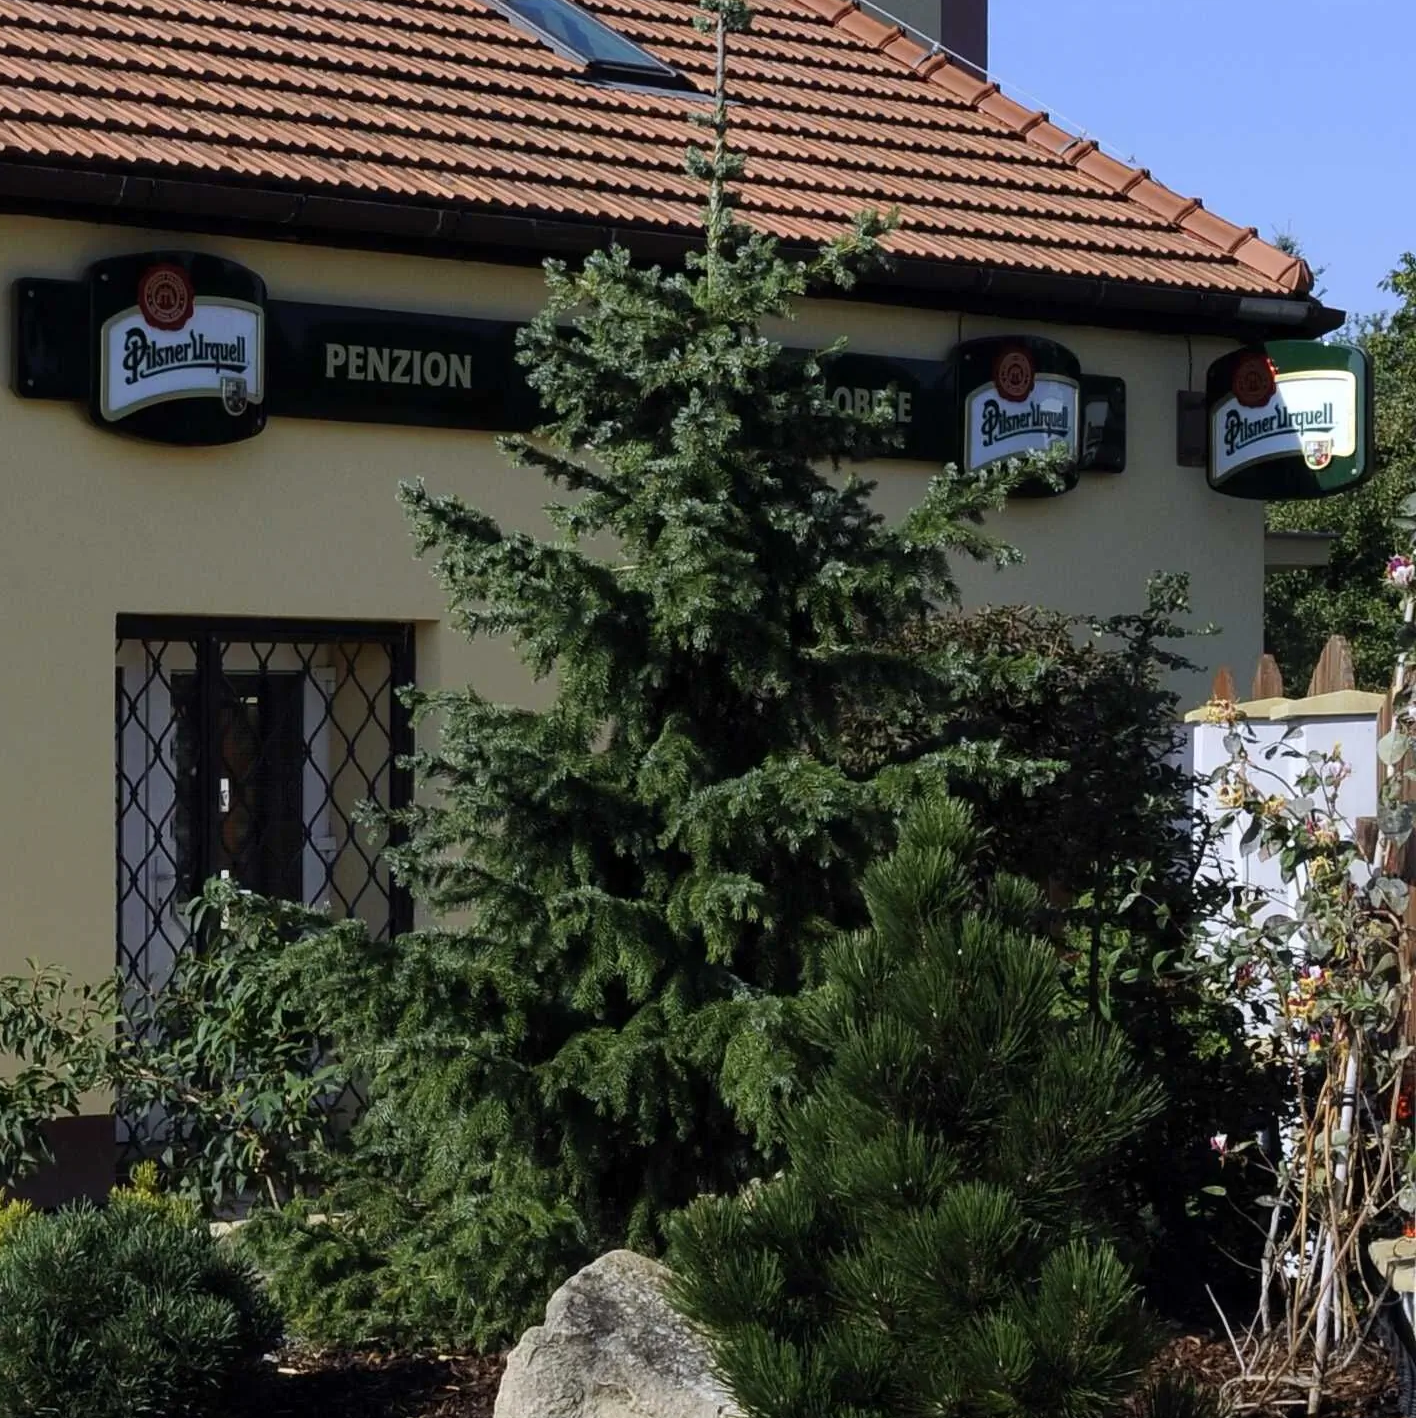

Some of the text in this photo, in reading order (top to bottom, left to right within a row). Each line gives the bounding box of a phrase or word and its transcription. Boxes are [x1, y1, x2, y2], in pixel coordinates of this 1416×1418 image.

[122, 326, 246, 385] Pilsner Urquell
[325, 342, 472, 389] PENZION
[981, 399, 1069, 447] Pilsner Urquell
[1224, 402, 1333, 456] Pilsner Urquell
